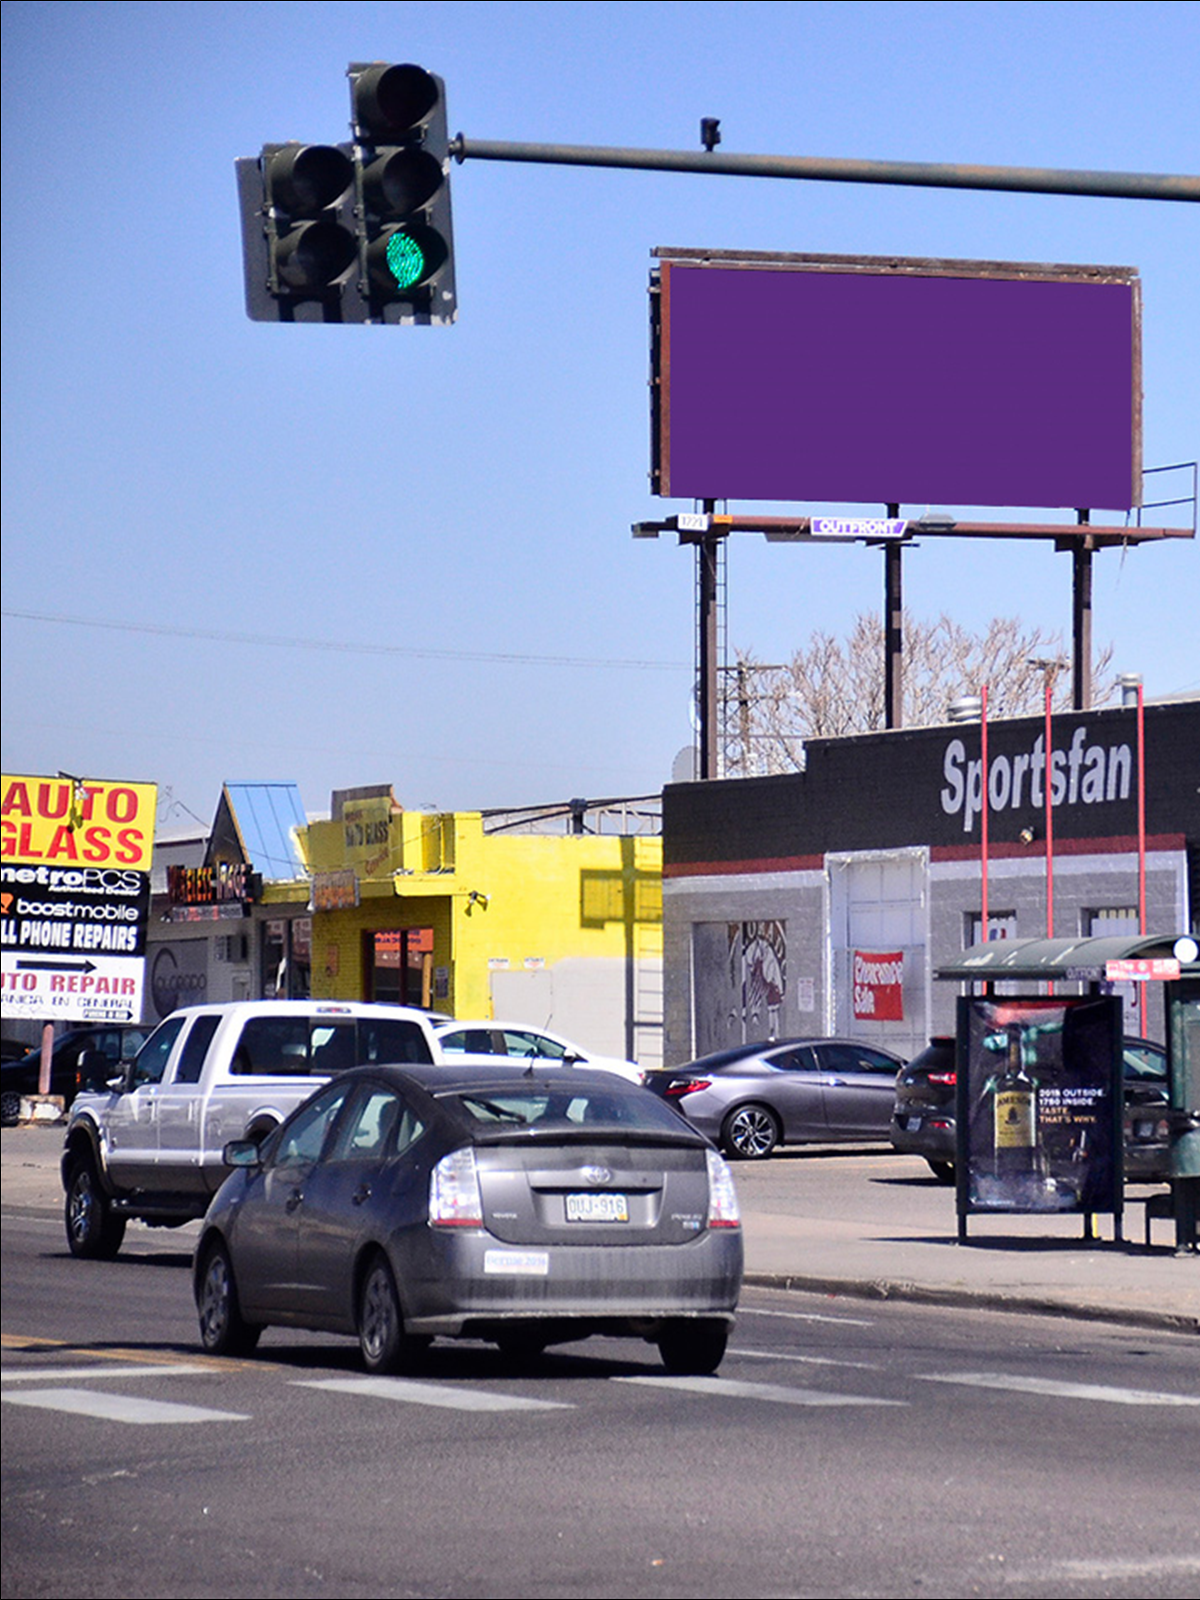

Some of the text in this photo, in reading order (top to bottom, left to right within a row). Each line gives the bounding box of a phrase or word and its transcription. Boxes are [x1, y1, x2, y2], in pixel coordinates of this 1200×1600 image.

[820, 519, 897, 535] OUTFRONT
[941, 726, 1132, 832] Sportsfan
[1, 782, 139, 823] AUTO
[1, 820, 144, 864] GLASS
[20, 920, 72, 947] PHONE
[73, 923, 137, 951] REPAIRS
[50, 974, 136, 995] REPAIR
[855, 957, 903, 985] Clearance
[855, 986, 875, 1014] Sale
